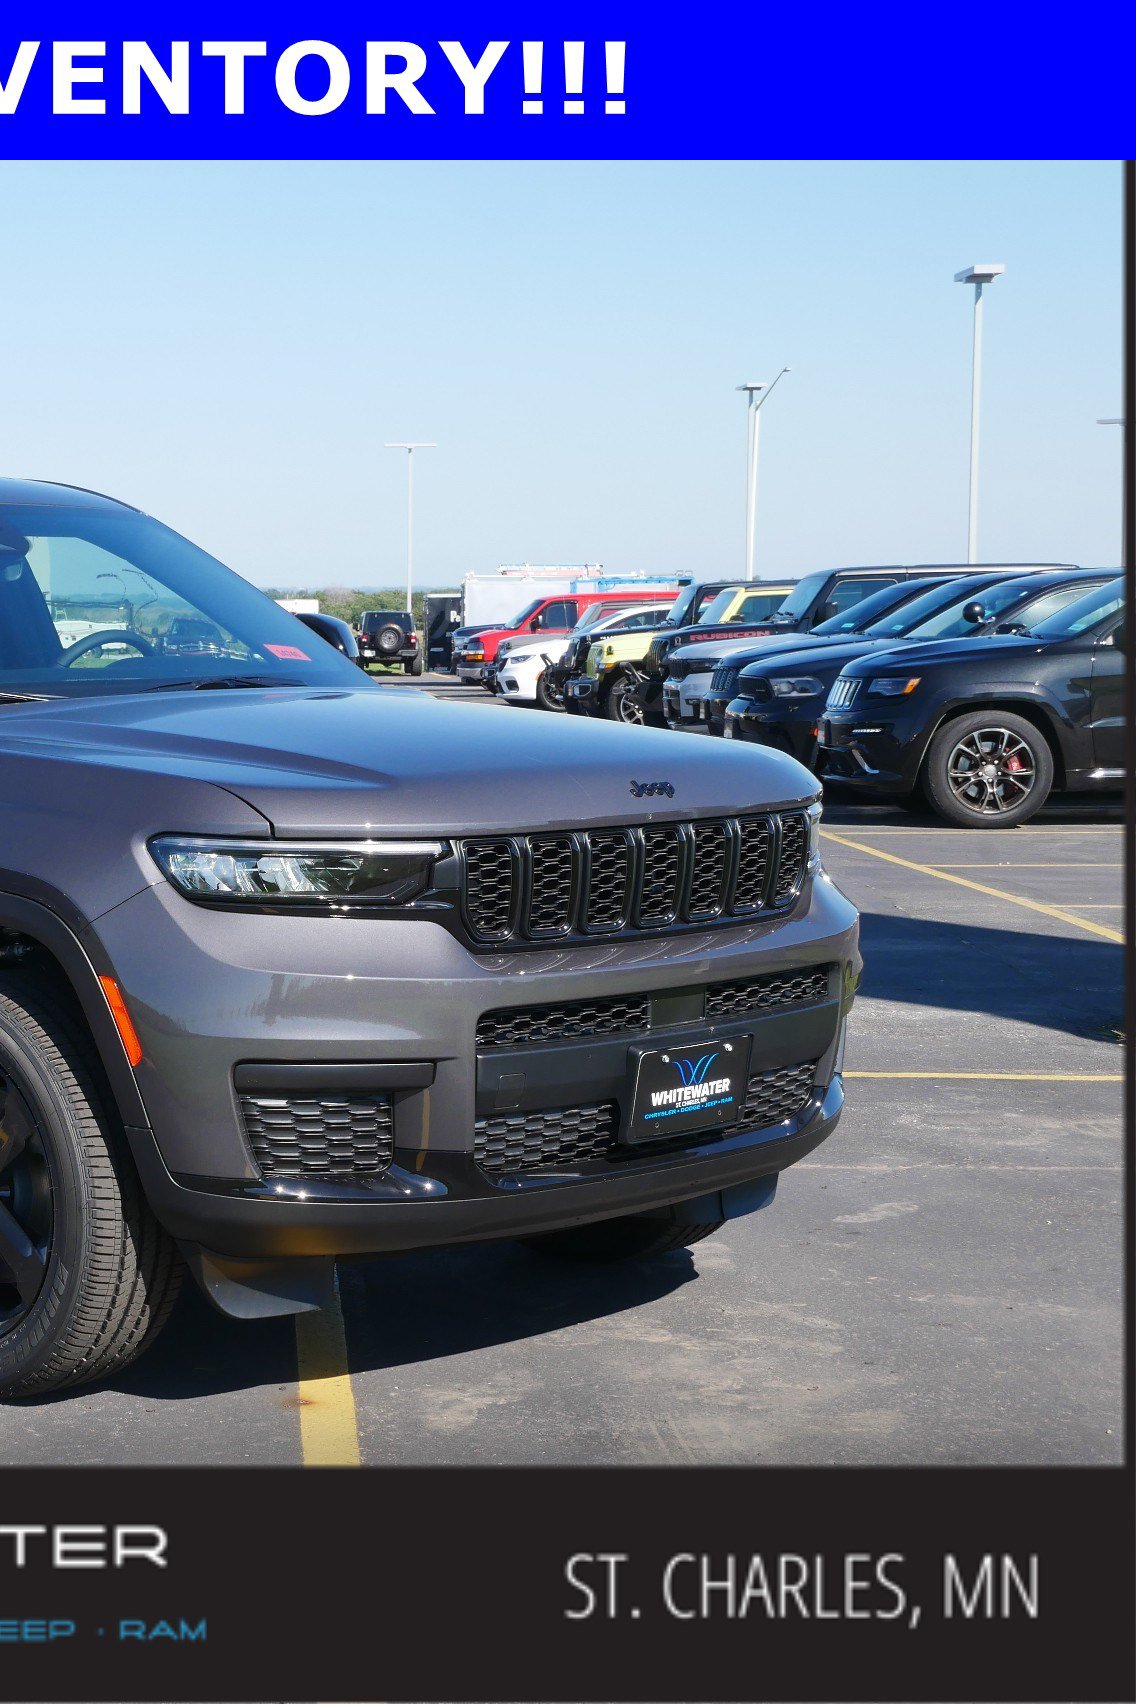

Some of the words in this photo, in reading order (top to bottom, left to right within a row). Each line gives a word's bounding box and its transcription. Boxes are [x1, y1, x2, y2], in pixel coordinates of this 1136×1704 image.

[689, 630, 771, 642] RUBICON
[629, 779, 676, 799] Jeep
[651, 1078, 731, 1107] WHITEWATER
[644, 1108, 677, 1120] CHRYSLER
[680, 1103, 701, 1113] DODGE
[704, 1100, 718, 1109] JEEP
[721, 1096, 733, 1105] RAM
